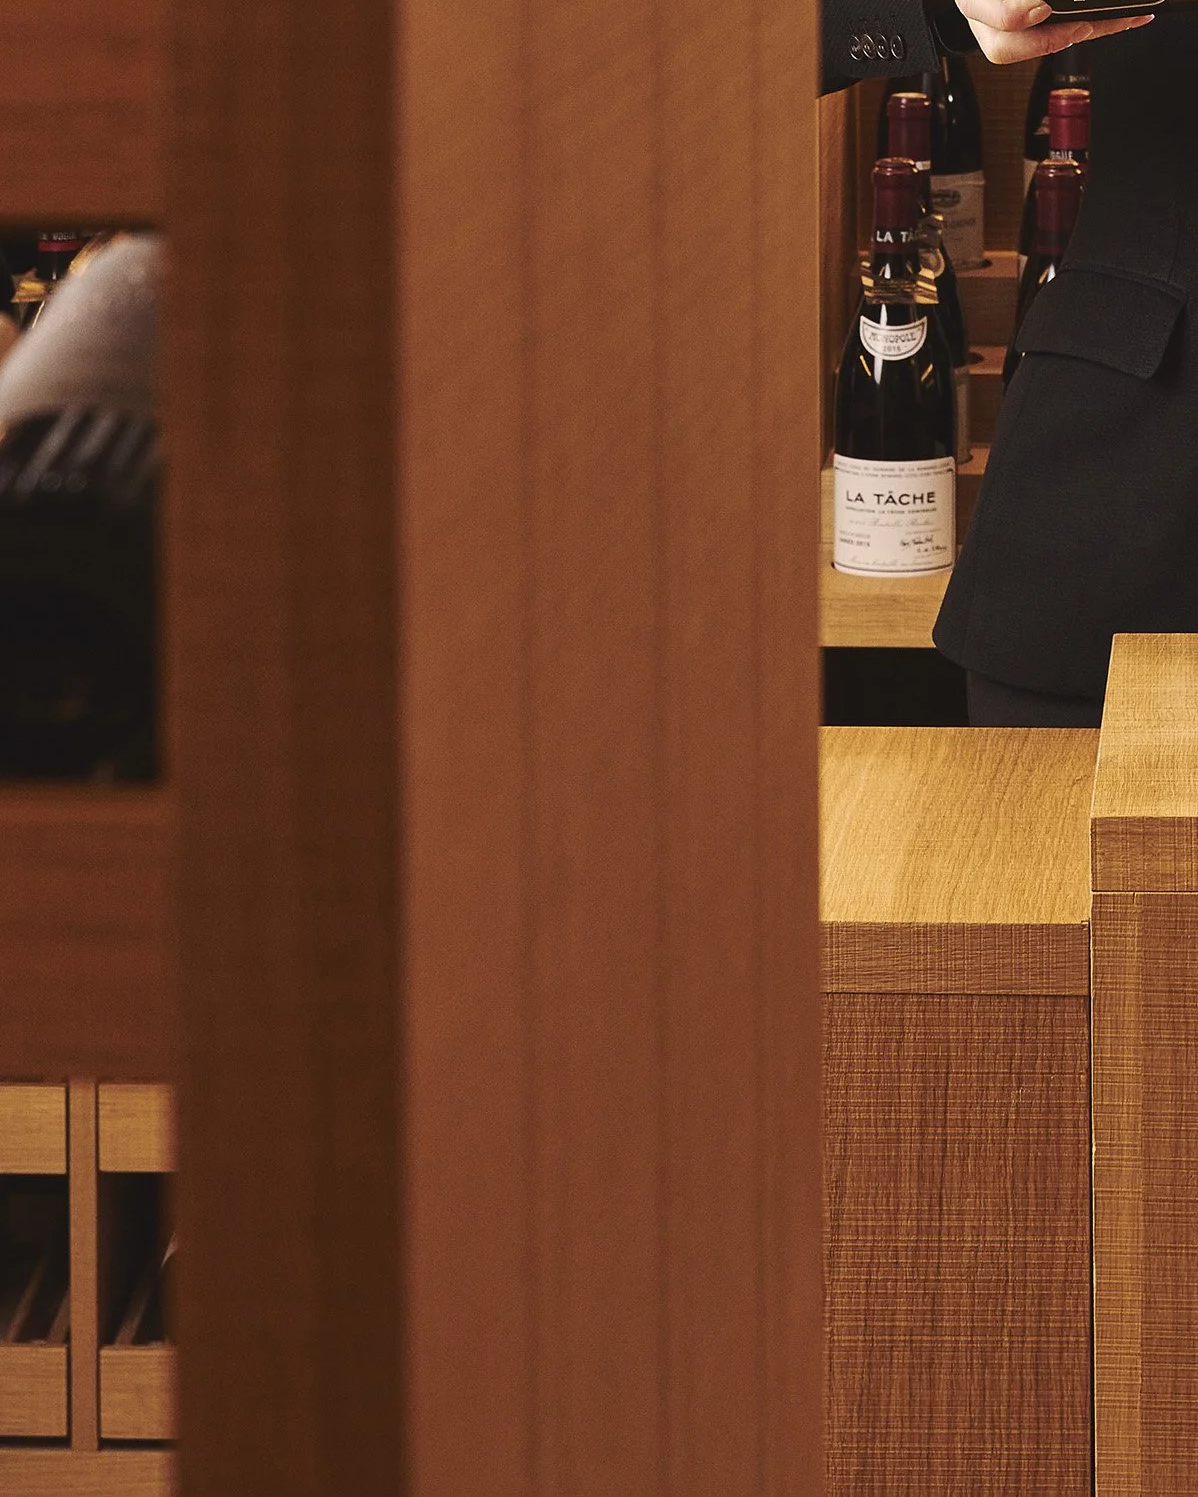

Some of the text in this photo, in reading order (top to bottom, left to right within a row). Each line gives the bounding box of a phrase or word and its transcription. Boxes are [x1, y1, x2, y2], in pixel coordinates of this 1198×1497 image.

[876, 230, 894, 243] LA
[868, 330, 917, 344] MONOPOLE
[846, 490, 936, 506] LA TÂCHE
